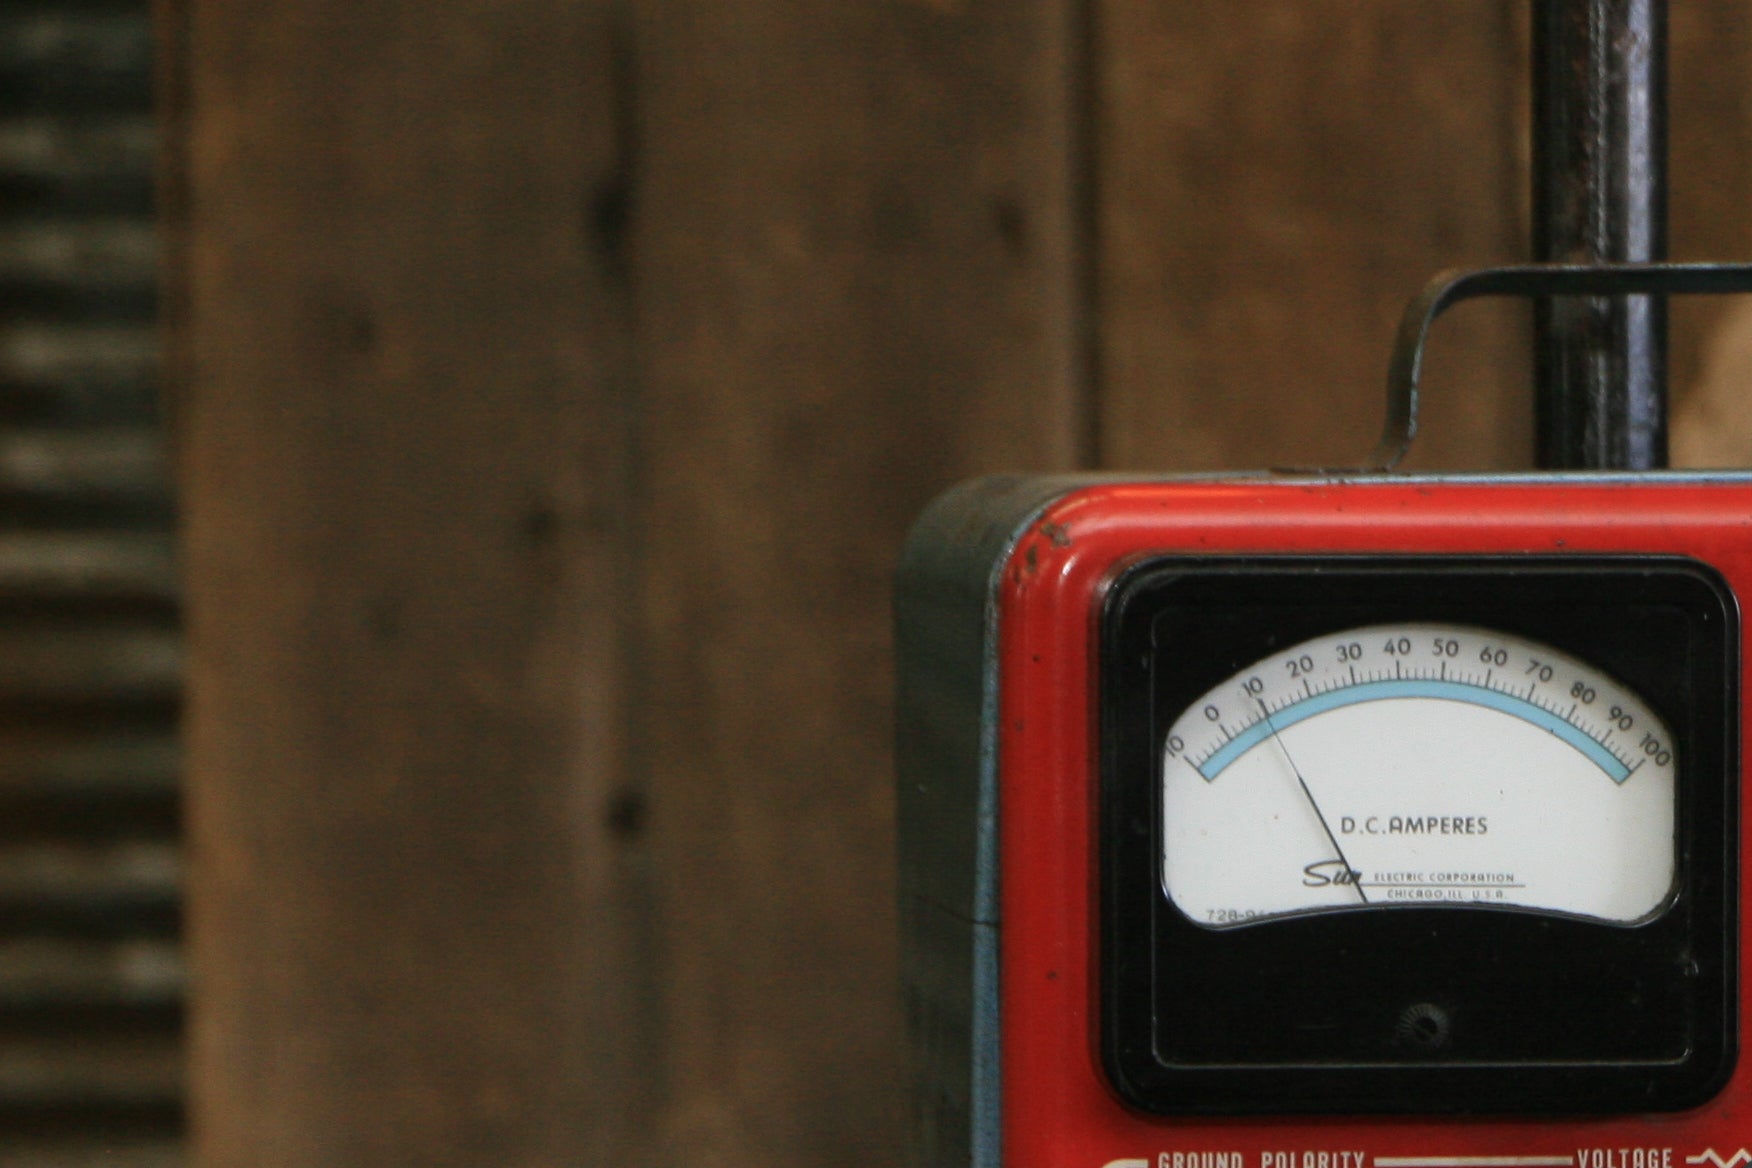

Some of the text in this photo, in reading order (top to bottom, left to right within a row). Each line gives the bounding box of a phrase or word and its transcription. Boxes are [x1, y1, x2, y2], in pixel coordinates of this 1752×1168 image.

[1204, 705, 1219, 722] 0
[1242, 677, 1263, 695] 10
[1286, 655, 1314, 677] 20
[1336, 643, 1362, 663] 30
[1383, 638, 1411, 655] 40
[1432, 638, 1459, 657] 50
[1480, 646, 1508, 666] 60
[1525, 660, 1553, 682] 70
[1570, 681, 1596, 704] 80
[1610, 706, 1633, 731] 90
[1638, 733, 1671, 766] 100
[1302, 859, 1515, 887] Sun ELECTRIC CORPORATION
